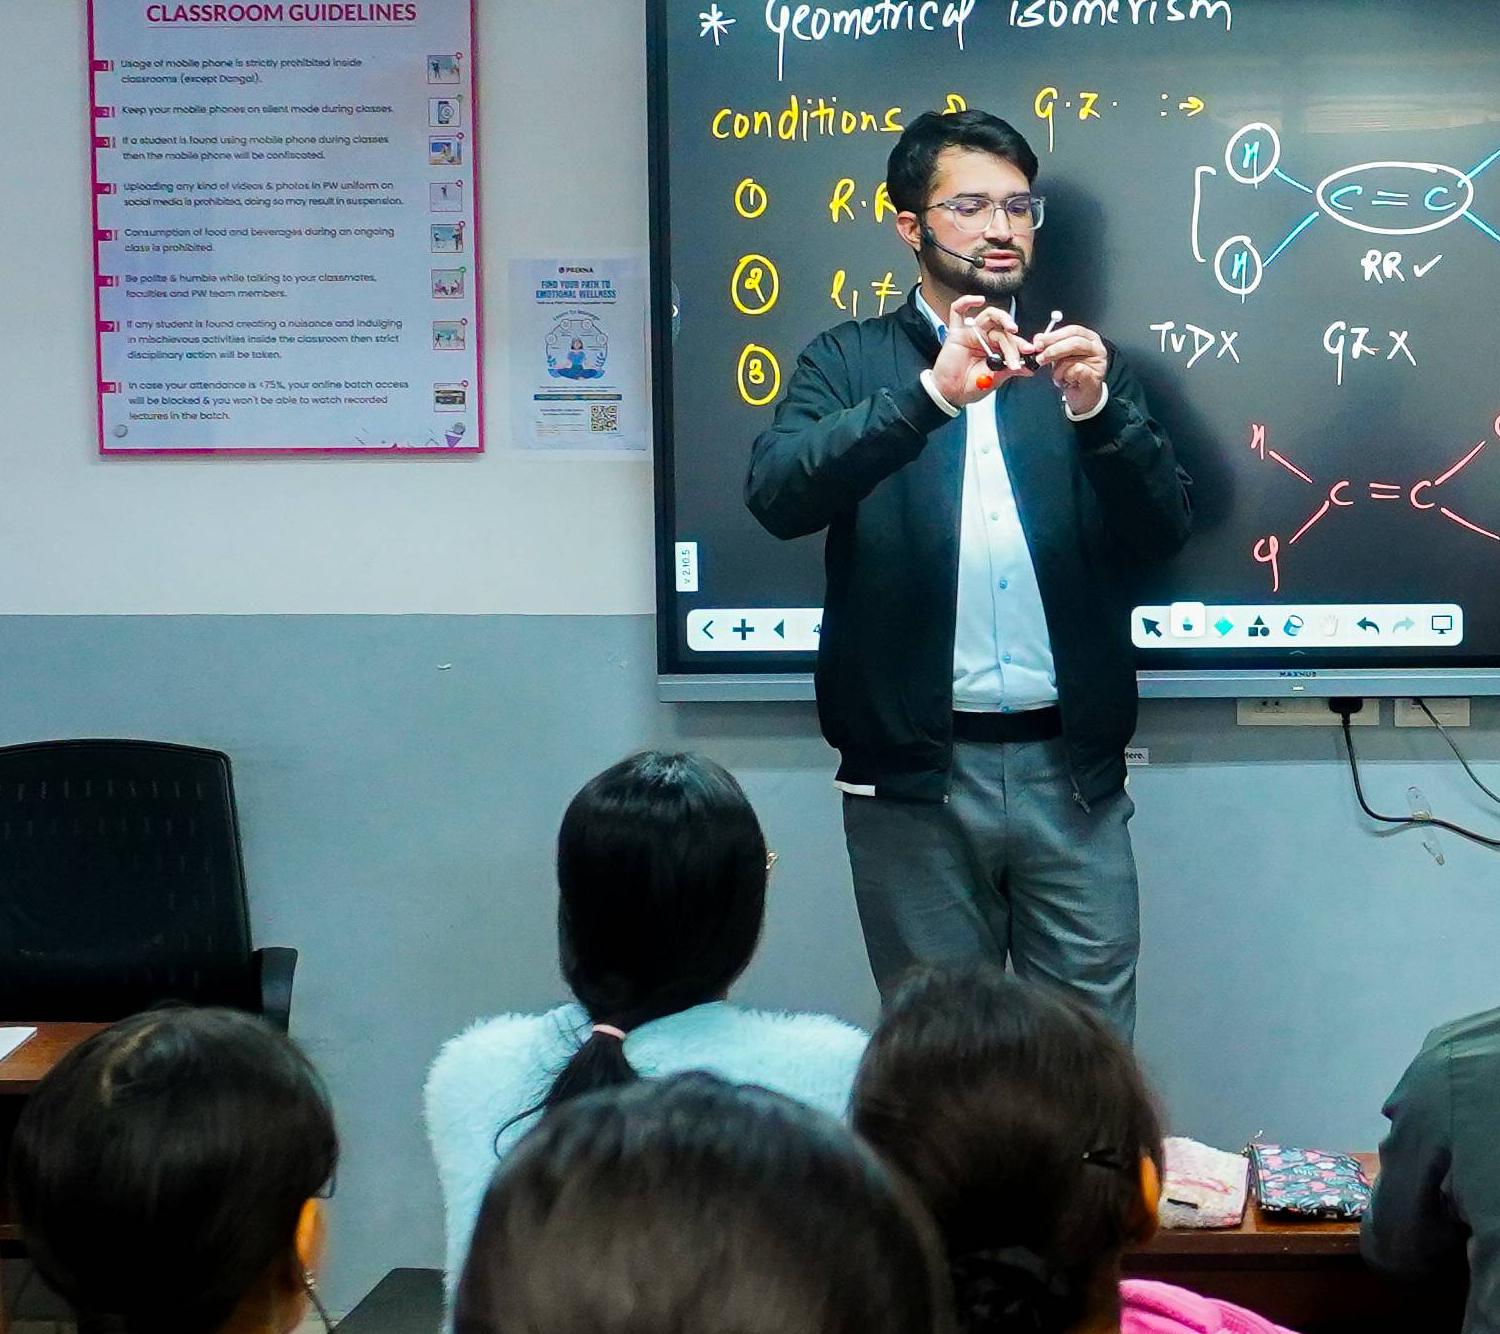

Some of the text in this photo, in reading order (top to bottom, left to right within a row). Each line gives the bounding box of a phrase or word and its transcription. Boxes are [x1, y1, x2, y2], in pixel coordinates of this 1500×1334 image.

[147, 3, 417, 22] CLASSROOM GUIDELINES
[121, 58, 362, 70] Usage of mobile phone is strictly prohibited inside
[121, 73, 178, 83] classrooms
[712, 93, 905, 141] conditions
[128, 381, 138, 389] In
[139, 381, 163, 389] case
[165, 382, 187, 391] your
[189, 380, 246, 389] attendance
[248, 380, 256, 389] is
[288, 381, 310, 391] your
[311, 380, 342, 389] online
[344, 380, 373, 389] batch
[374, 380, 409, 389] access
[1329, 480, 1354, 506] C
[1410, 480, 1436, 509] C
